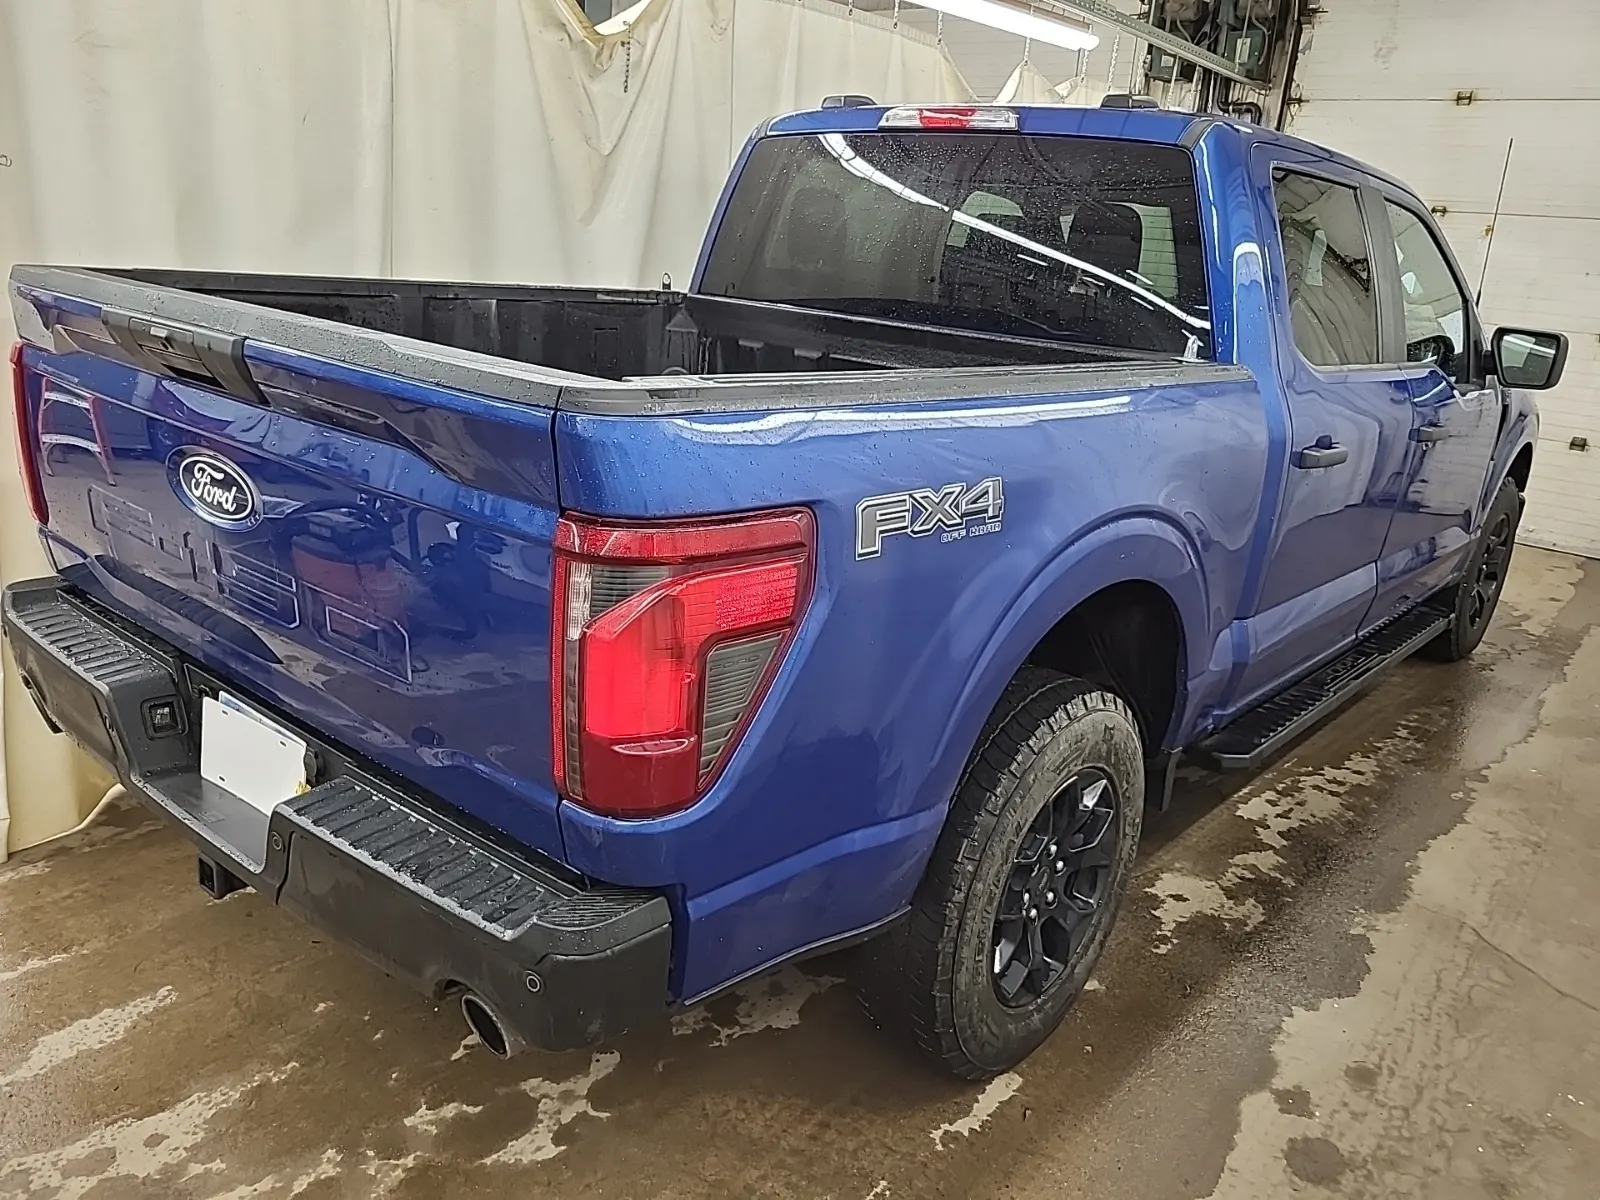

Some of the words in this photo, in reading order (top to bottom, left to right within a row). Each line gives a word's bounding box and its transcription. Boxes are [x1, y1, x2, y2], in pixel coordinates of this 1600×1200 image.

[191, 462, 237, 512] Ford
[855, 476, 1003, 561] FX4
[940, 529, 966, 543] OFF
[970, 522, 1001, 537] ROAD
[88, 484, 412, 684] F-150
